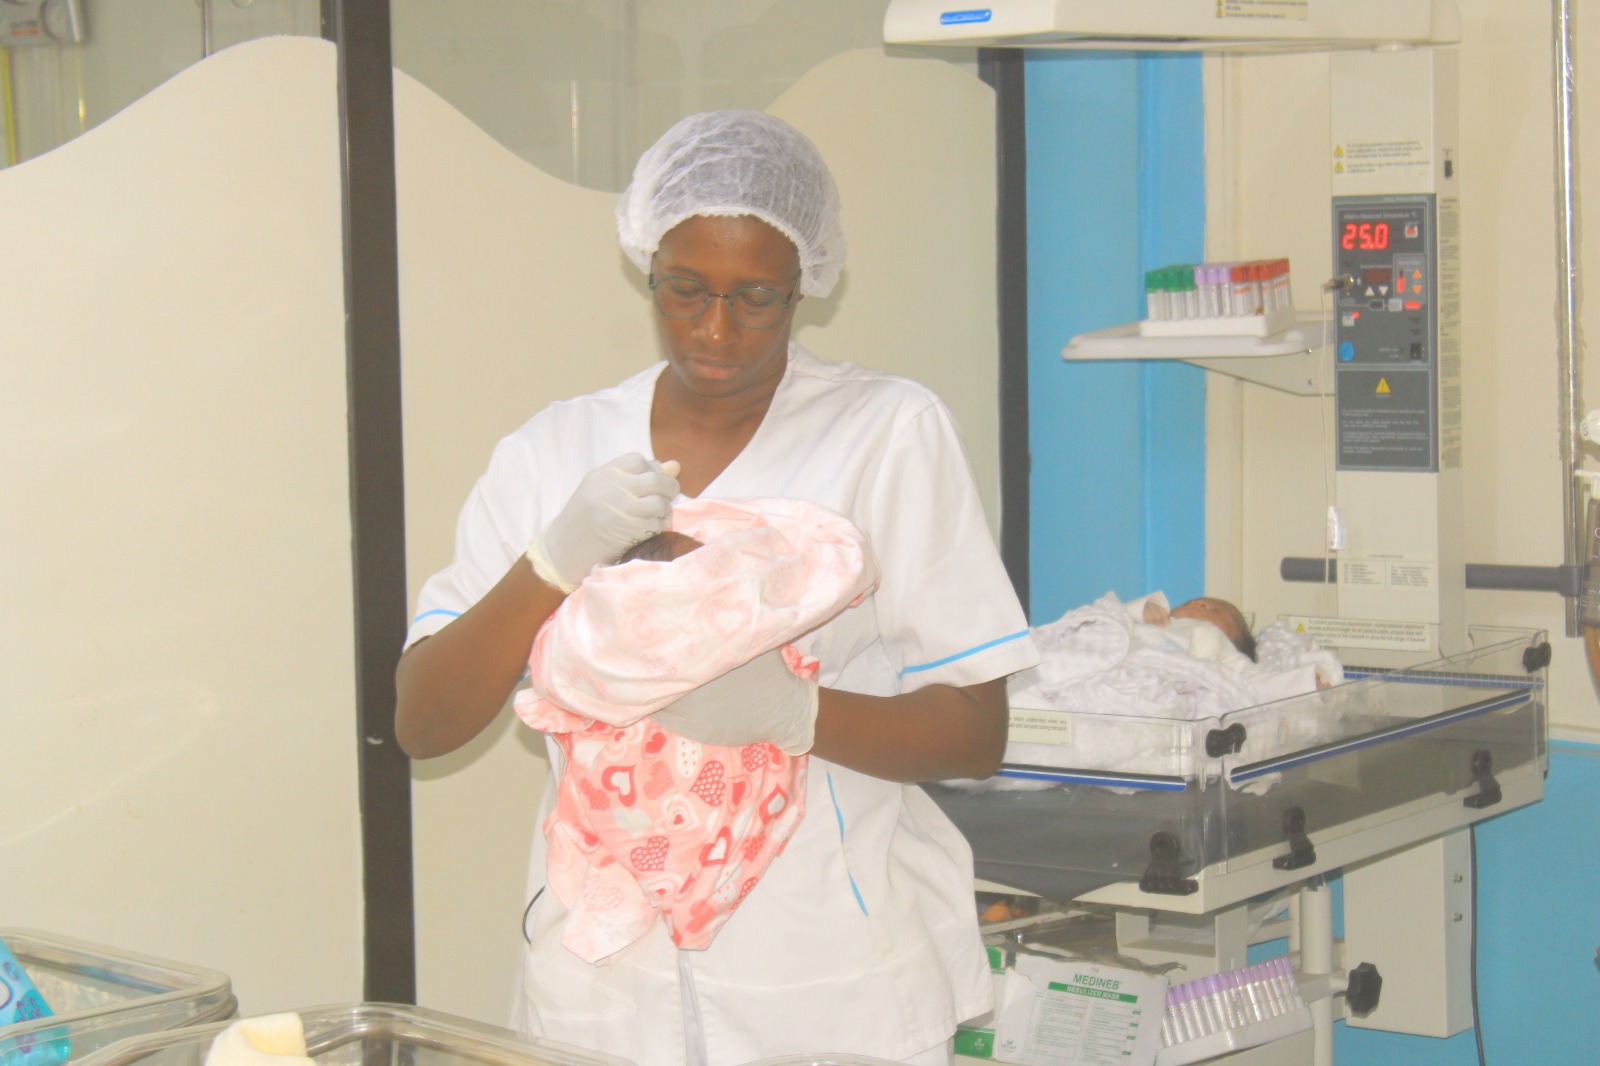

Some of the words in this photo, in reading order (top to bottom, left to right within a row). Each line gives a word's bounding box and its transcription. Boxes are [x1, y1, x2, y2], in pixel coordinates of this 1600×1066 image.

[1342, 223, 1389, 250] 25.0
[1073, 973, 1120, 990] MEDINEB
[1066, 985, 1102, 997] NEBULIZER
[1101, 991, 1120, 1001] MASK
